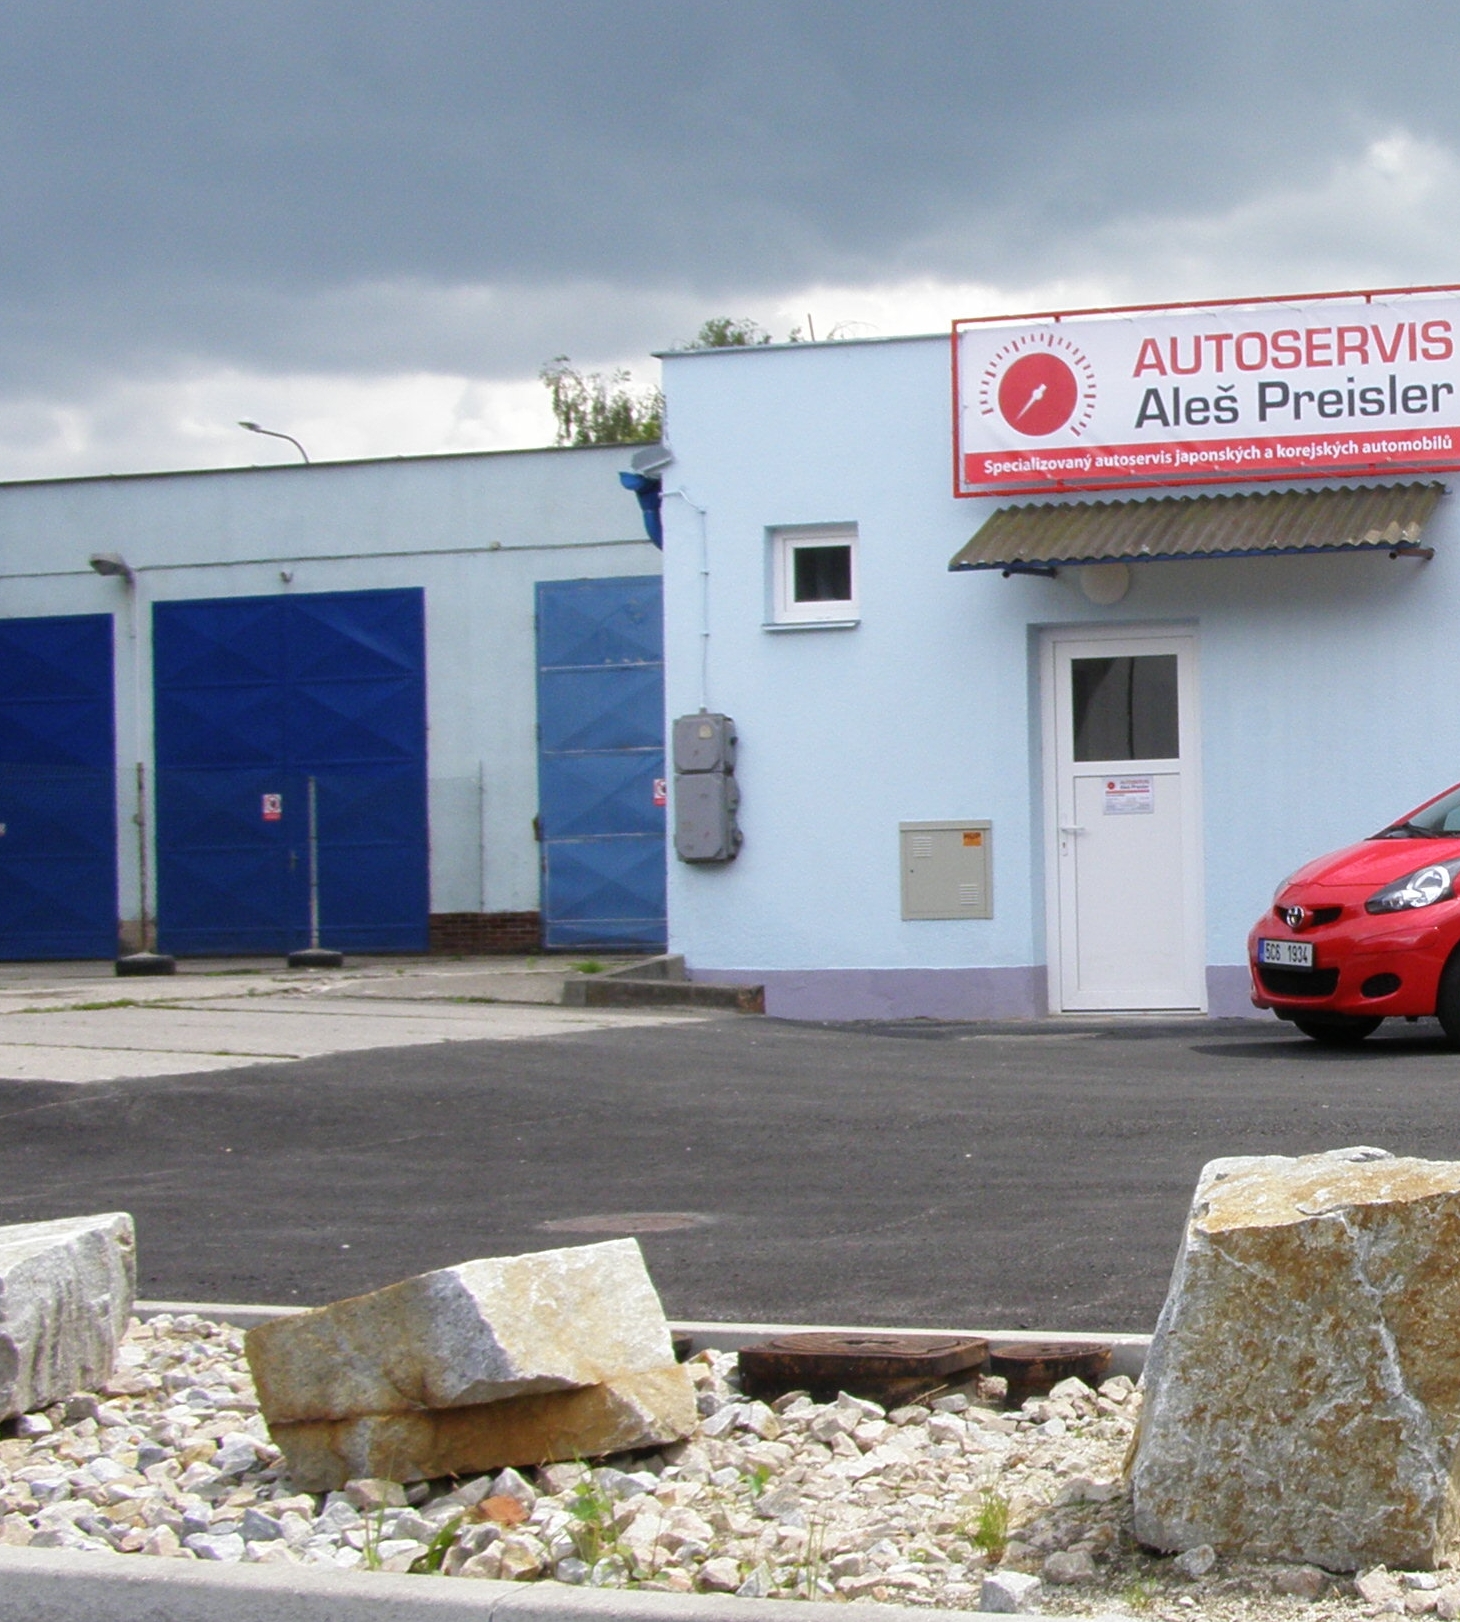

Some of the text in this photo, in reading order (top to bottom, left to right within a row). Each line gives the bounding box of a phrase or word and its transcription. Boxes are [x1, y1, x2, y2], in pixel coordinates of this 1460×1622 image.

[1132, 320, 1454, 377] AUTOSERVIS
[1134, 374, 1454, 429] Aleš Preisler
[984, 435, 1453, 476] Specializovaný autoservis japonských a korejských automobilů
[1288, 945, 1308, 963] 1934
